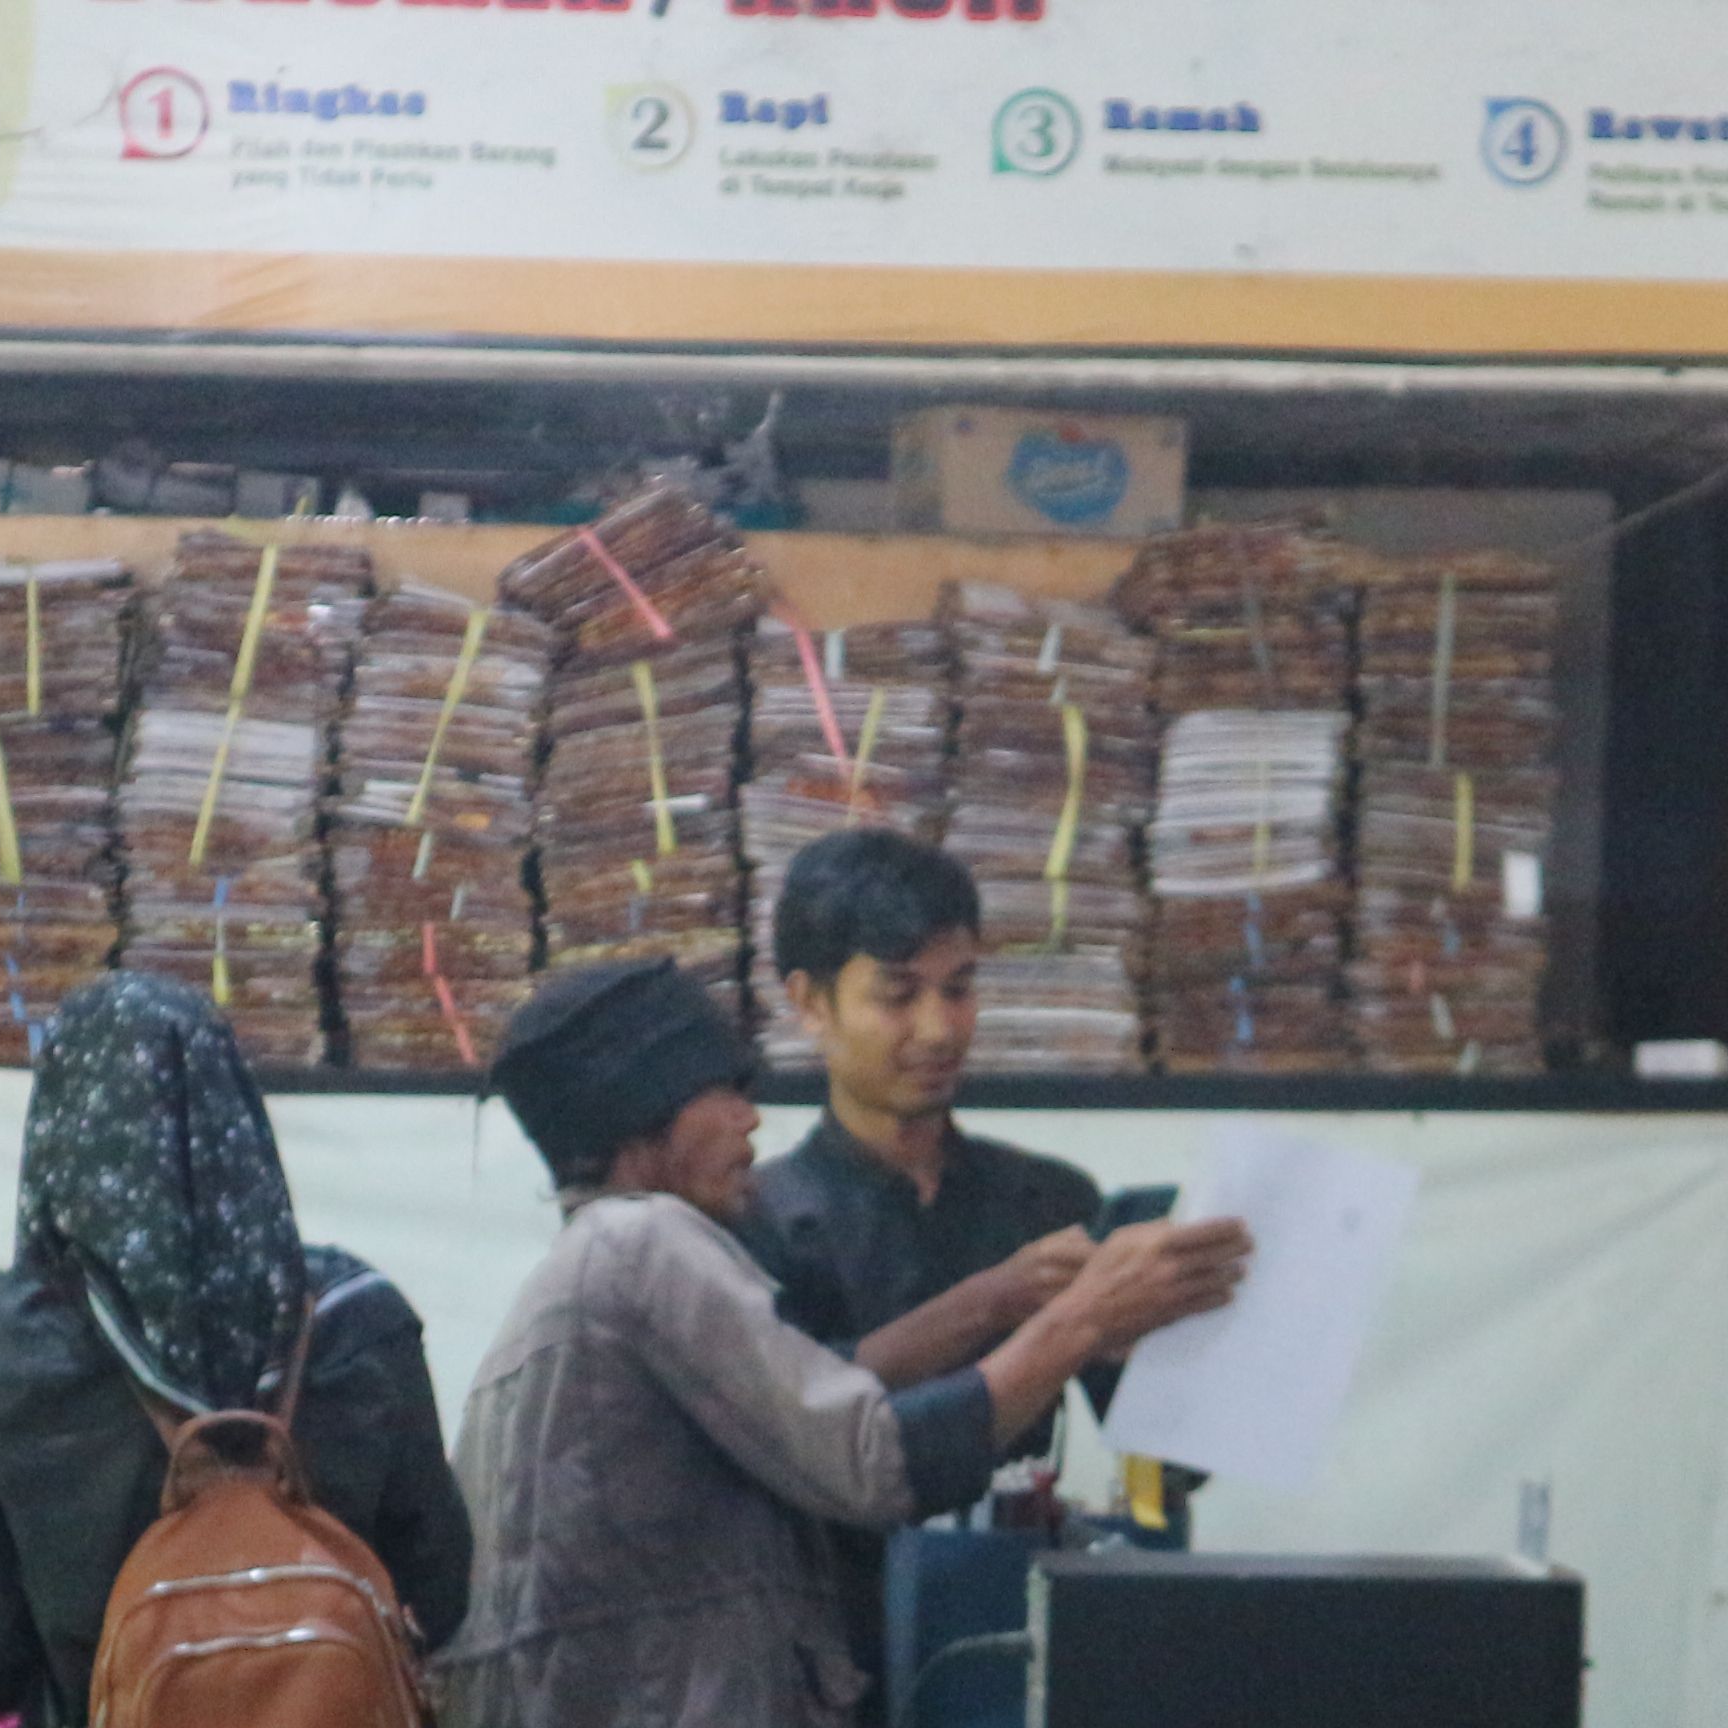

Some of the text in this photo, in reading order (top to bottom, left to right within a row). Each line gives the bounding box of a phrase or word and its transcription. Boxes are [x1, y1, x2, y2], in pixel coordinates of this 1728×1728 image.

[148, 88, 173, 139] 1
[632, 97, 669, 150] 2
[1017, 104, 1057, 158] 3
[1503, 118, 1536, 167] 4
